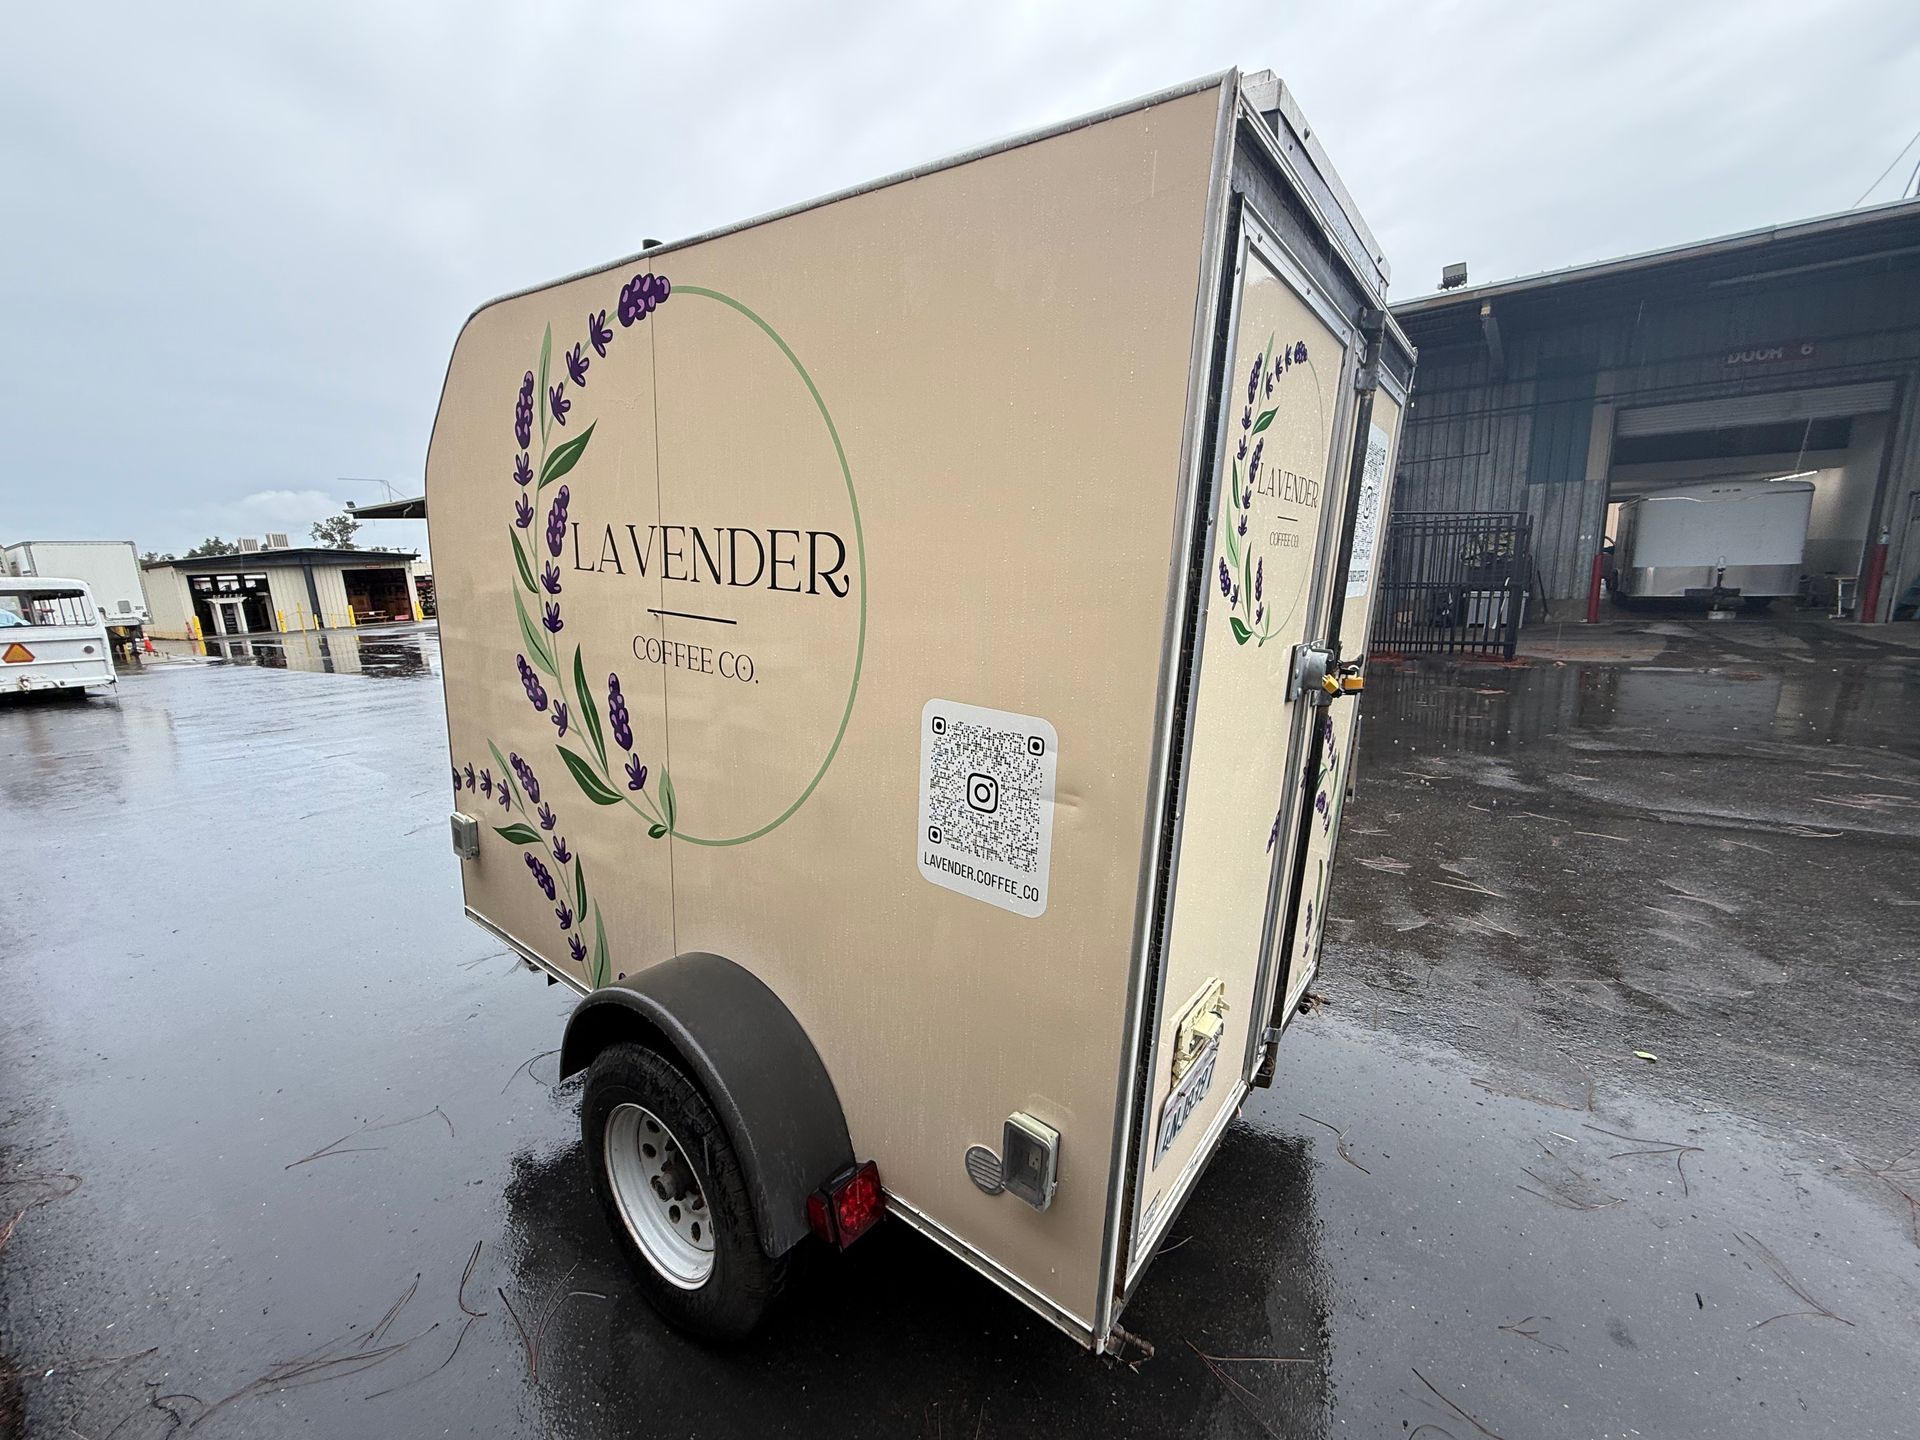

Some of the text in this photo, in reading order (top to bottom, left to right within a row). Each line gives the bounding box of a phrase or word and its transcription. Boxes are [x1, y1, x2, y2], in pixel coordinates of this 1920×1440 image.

[1257, 462, 1319, 508] LAVENDER
[571, 522, 849, 598] LAVENDER
[1269, 531, 1291, 547] COFFEE
[633, 635, 759, 685] COFFEE CO.
[924, 851, 1040, 902] LAVENDER.COFFEE_CO
